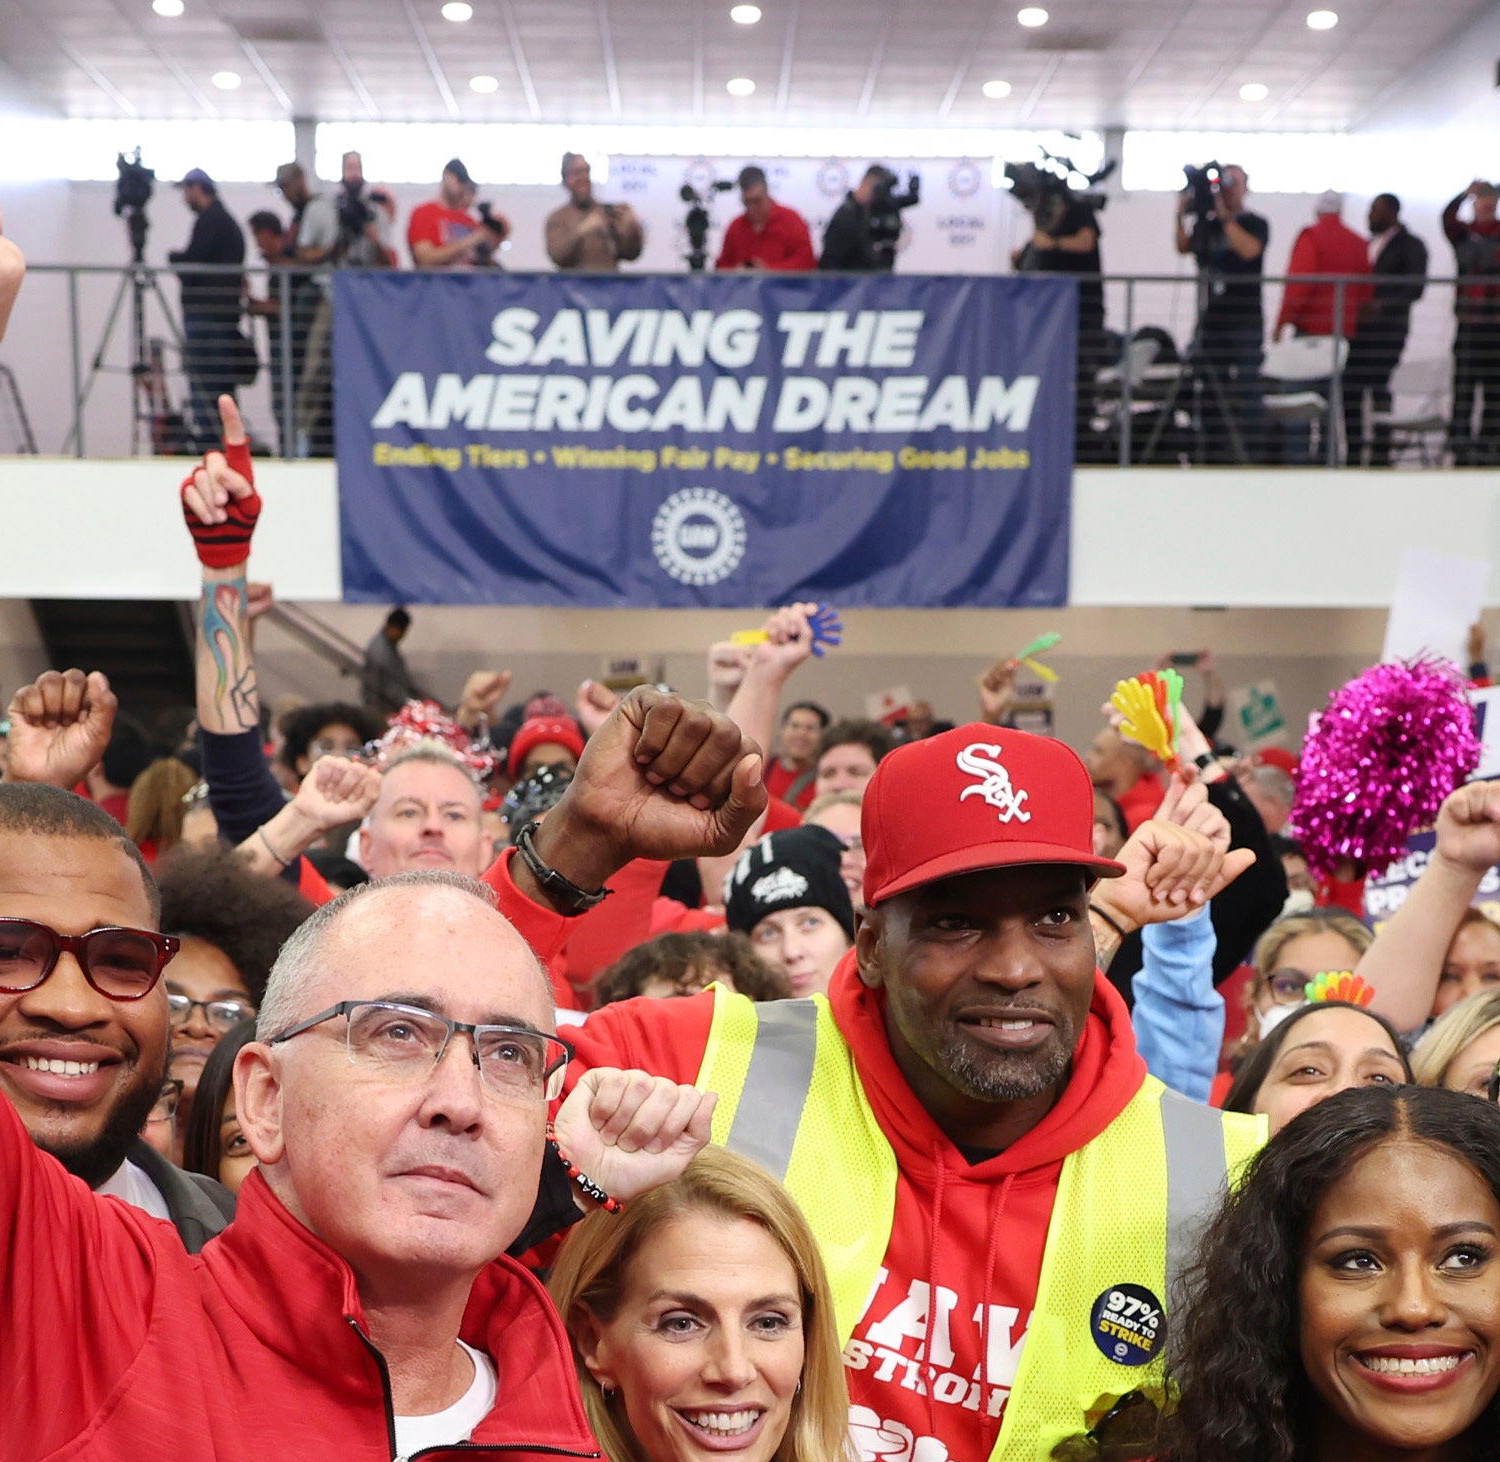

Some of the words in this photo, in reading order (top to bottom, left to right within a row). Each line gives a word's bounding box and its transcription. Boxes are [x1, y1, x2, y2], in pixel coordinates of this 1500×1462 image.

[486, 308, 763, 368] SAVING
[777, 310, 925, 368] THE
[371, 371, 768, 432] AMERICAN
[773, 375, 1040, 432] DREAM
[374, 444, 461, 469] Ending
[466, 446, 528, 468] Tiers
[551, 447, 657, 472] Winning
[661, 447, 709, 471] Fair
[714, 447, 761, 473] Pay
[784, 446, 894, 472] Securing
[898, 446, 964, 471] Good
[971, 446, 1031, 470] Jobs
[1102, 1309, 1141, 1331] READY
[1141, 1325, 1156, 1339] TO
[1106, 1290, 1160, 1329] 97%
[1098, 1319, 1154, 1352] STRIKE
[842, 1338, 1010, 1419] STRON
